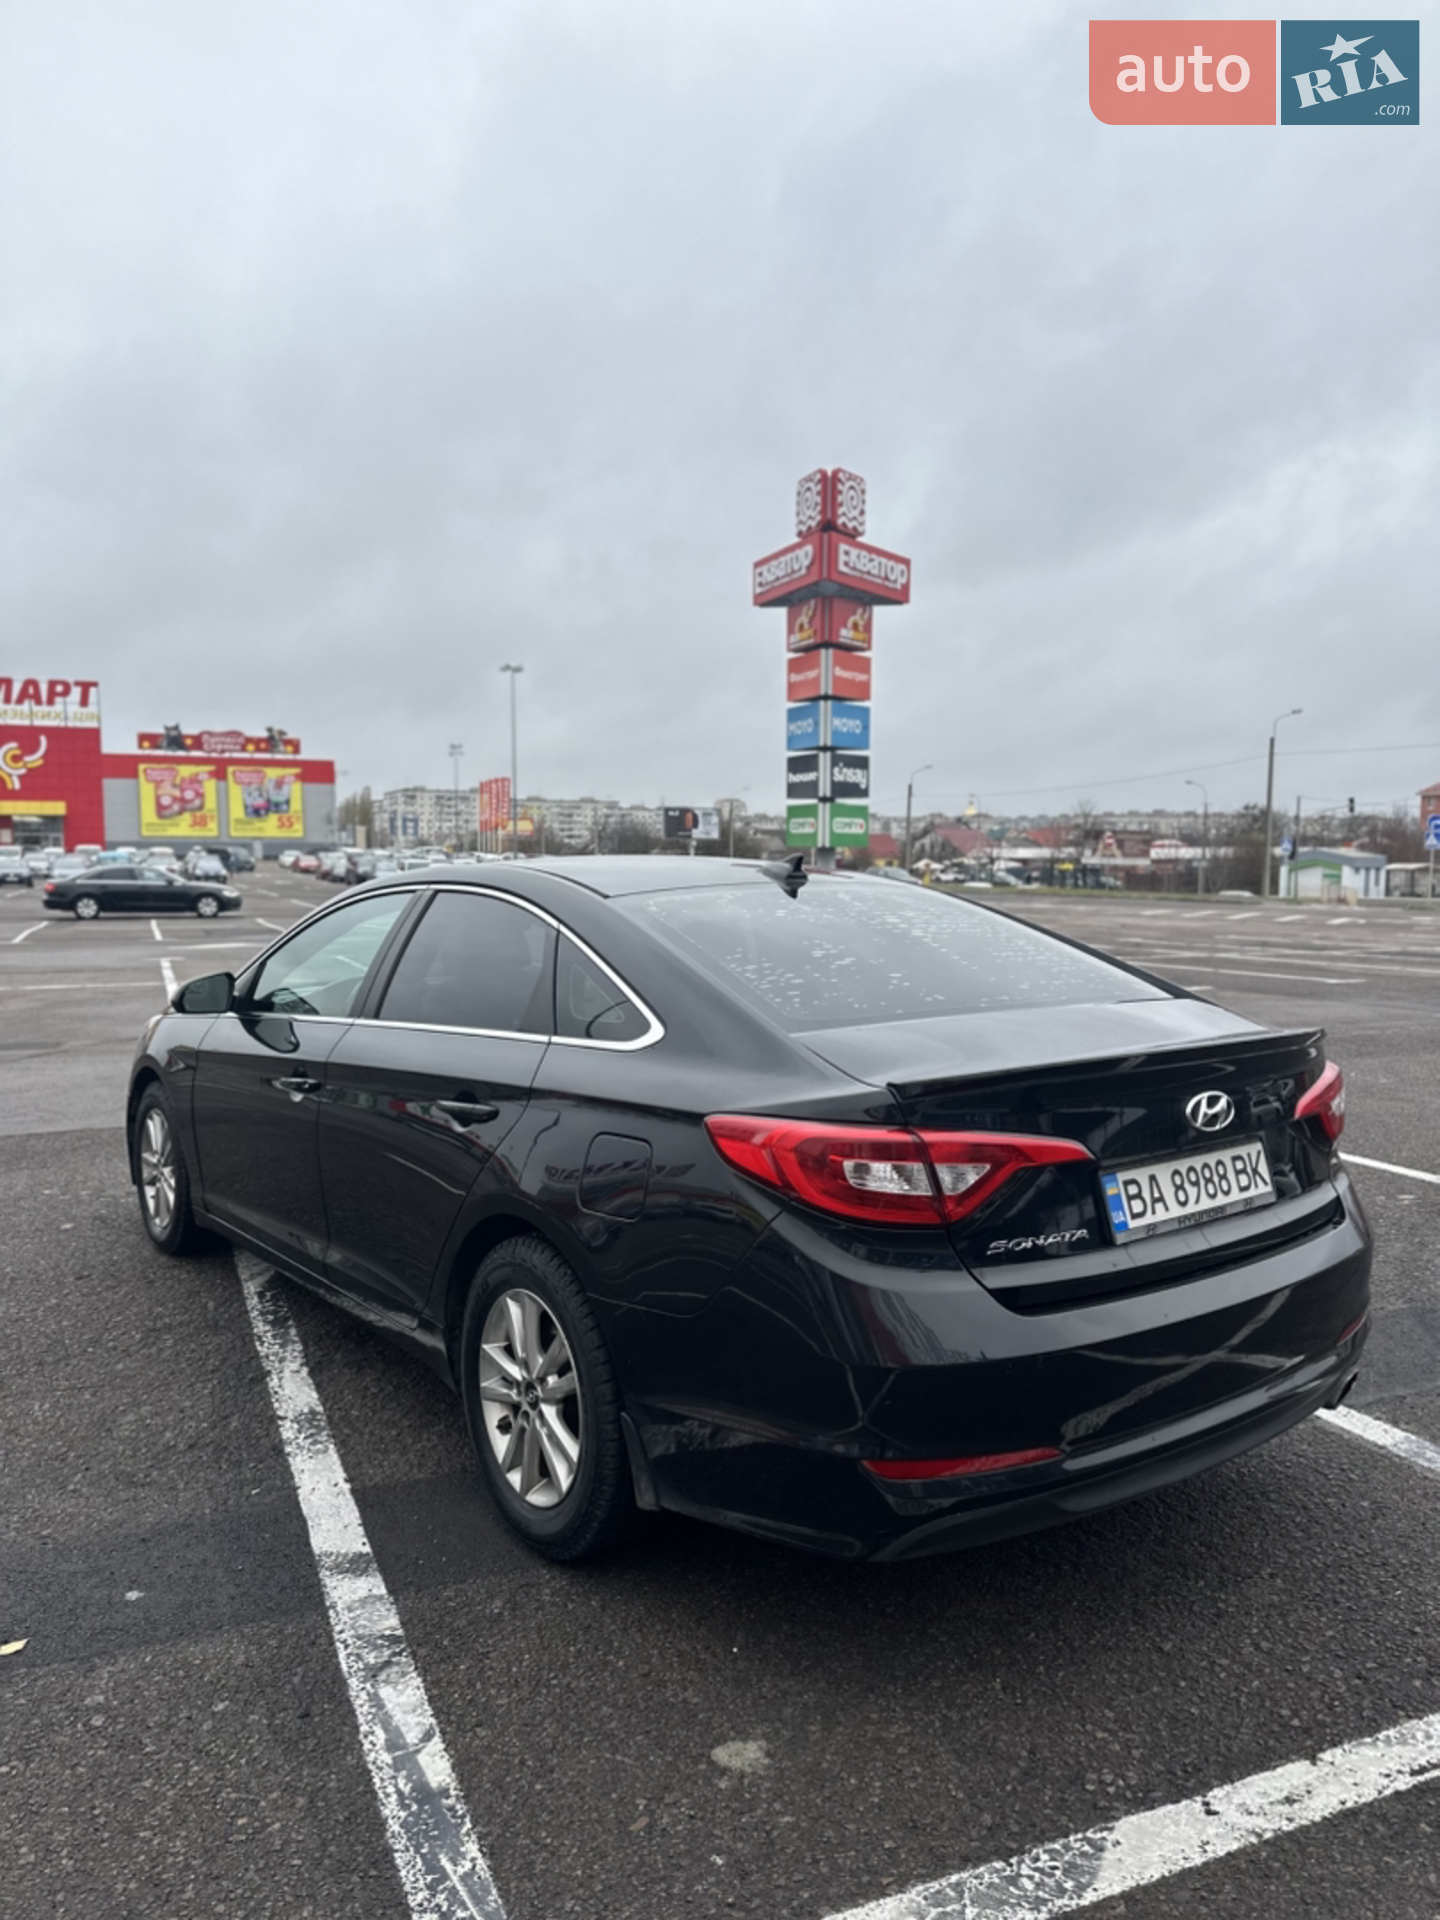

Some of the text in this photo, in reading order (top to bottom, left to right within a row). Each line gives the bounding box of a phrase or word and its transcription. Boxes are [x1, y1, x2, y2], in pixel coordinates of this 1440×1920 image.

[1122, 1149, 1269, 1221] BA 8988 BK
[1111, 1210, 1126, 1224] UA
[987, 1228, 1090, 1255] SONATA
